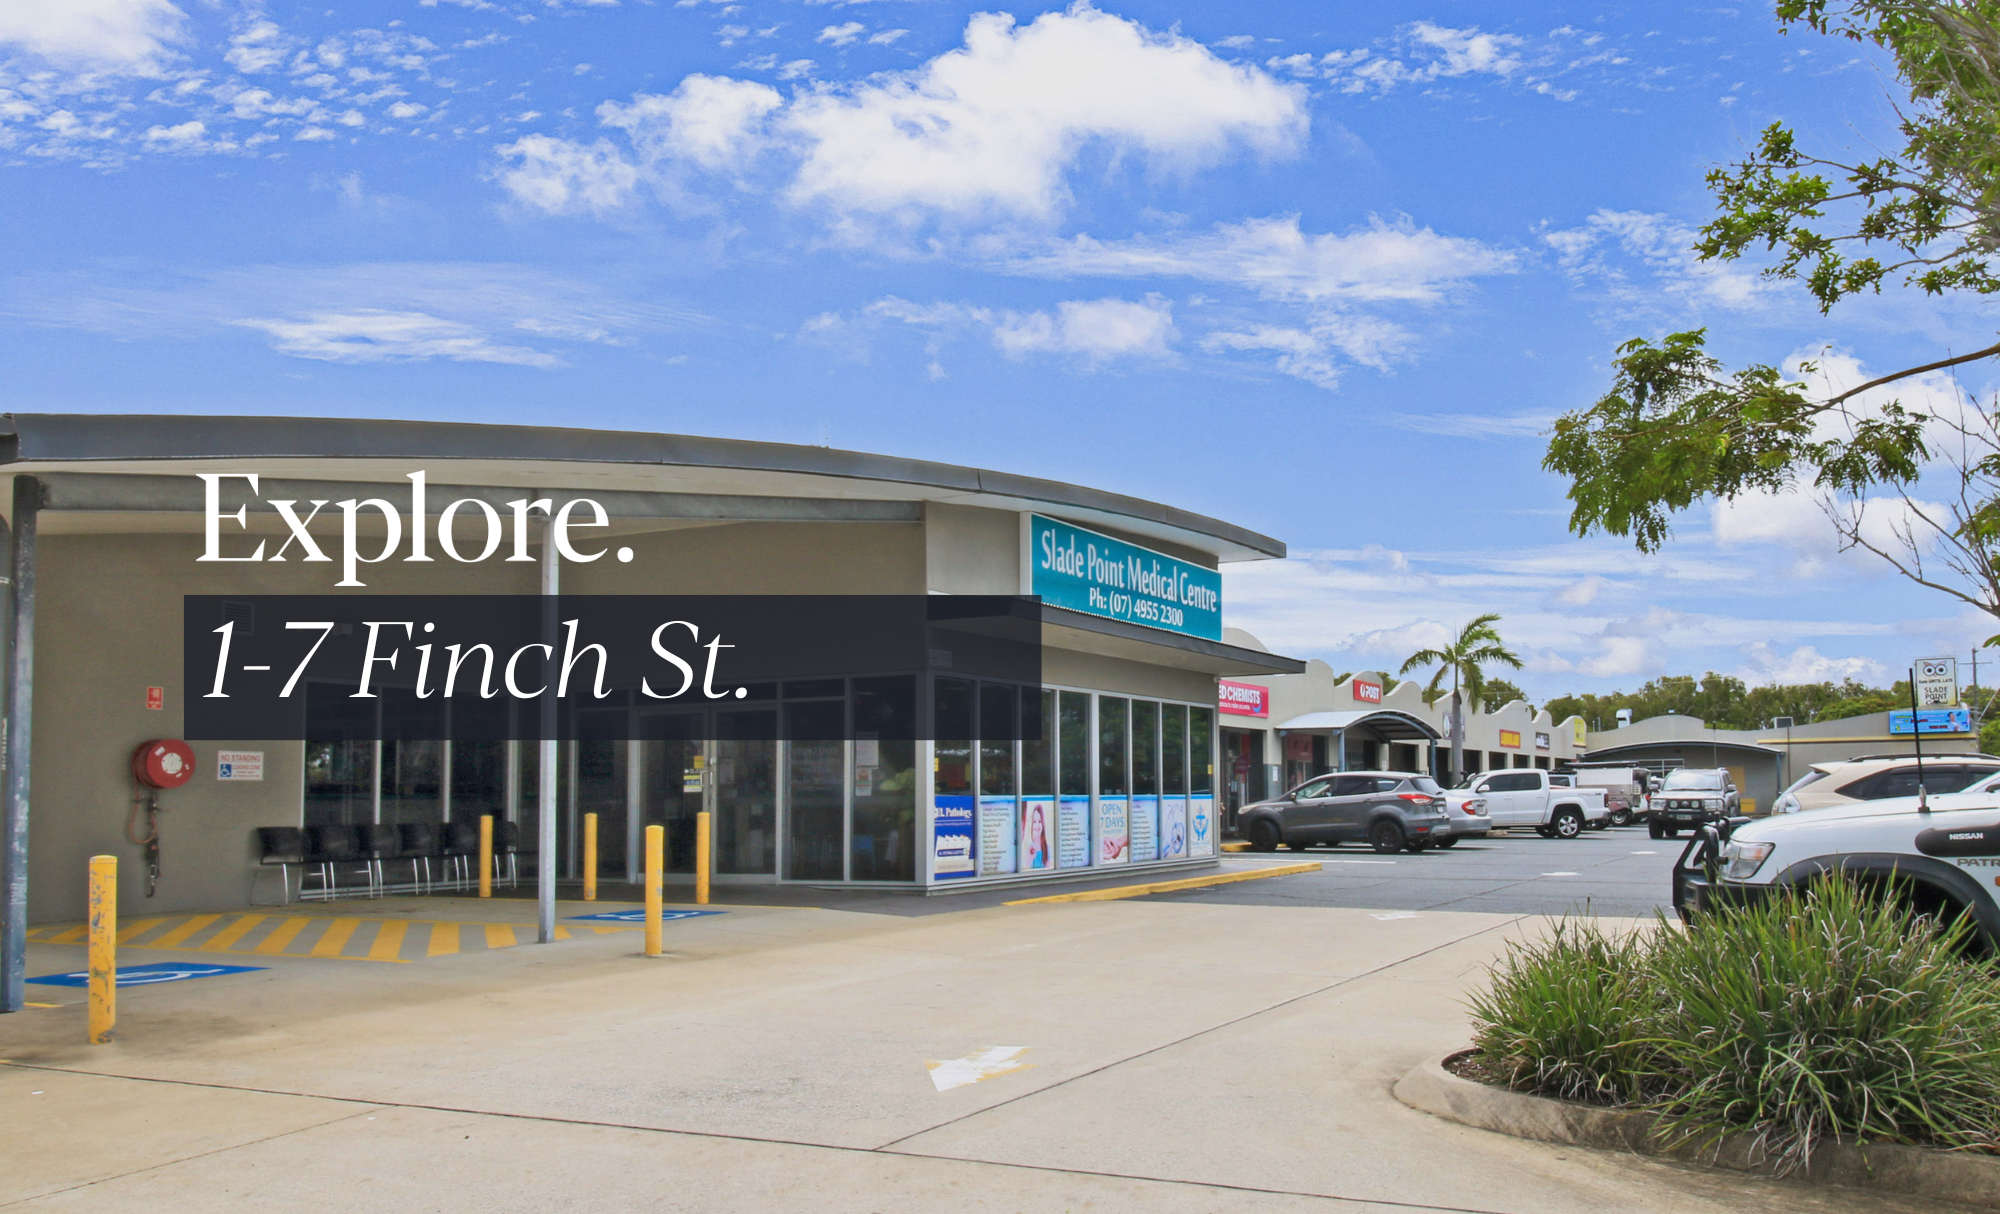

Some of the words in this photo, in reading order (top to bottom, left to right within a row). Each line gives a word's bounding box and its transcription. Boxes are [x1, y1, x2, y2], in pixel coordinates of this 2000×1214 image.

[1041, 528, 1084, 578] Slade
[1087, 543, 1125, 589] Point
[1127, 555, 1177, 602] Medical
[1179, 572, 1217, 612] Centre
[1089, 587, 1107, 610] Ph:
[1109, 590, 1132, 619] (07)
[1133, 599, 1159, 622] 4955
[1160, 605, 1183, 627] 2300
[1227, 686, 1261, 704] CHEMISTS
[1365, 685, 1380, 700] POST
[1924, 686, 1948, 694] SLADE
[1925, 693, 1947, 701] POINT
[231, 754, 261, 763] STANDING
[1102, 803, 1122, 815] OPEN
[1100, 816, 1104, 828] 7
[1105, 816, 1125, 828] DAYS
[1949, 832, 1984, 840] NISSAN
